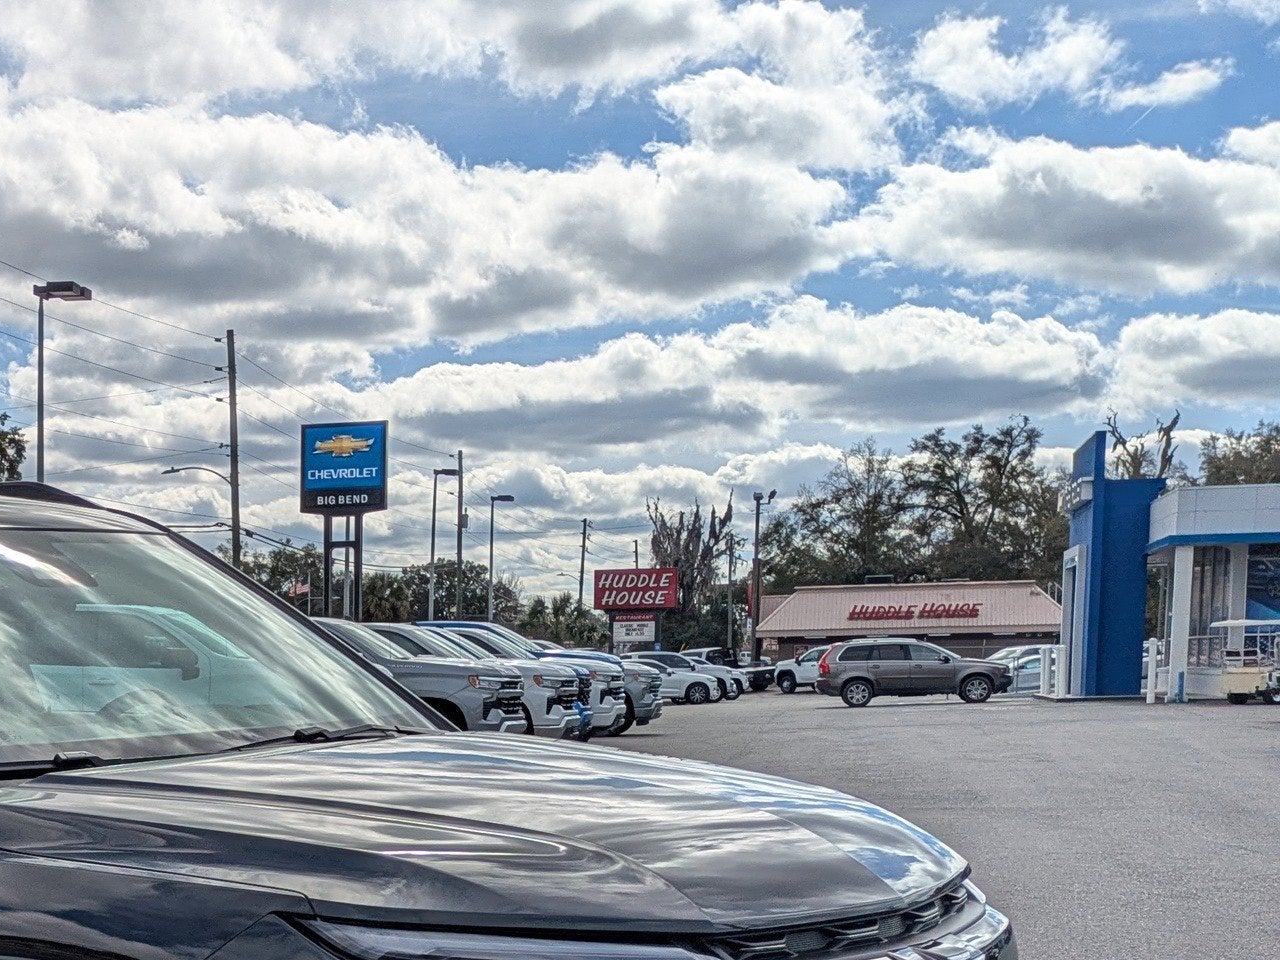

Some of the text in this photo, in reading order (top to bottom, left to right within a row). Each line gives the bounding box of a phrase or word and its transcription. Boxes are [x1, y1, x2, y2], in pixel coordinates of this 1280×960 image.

[307, 467, 378, 480] CHEVROLET
[317, 494, 369, 505] BIG BEND
[598, 573, 673, 588] HUDDLE
[601, 590, 669, 606] HOUSE
[847, 602, 984, 621] HUDDLE HOUSE
